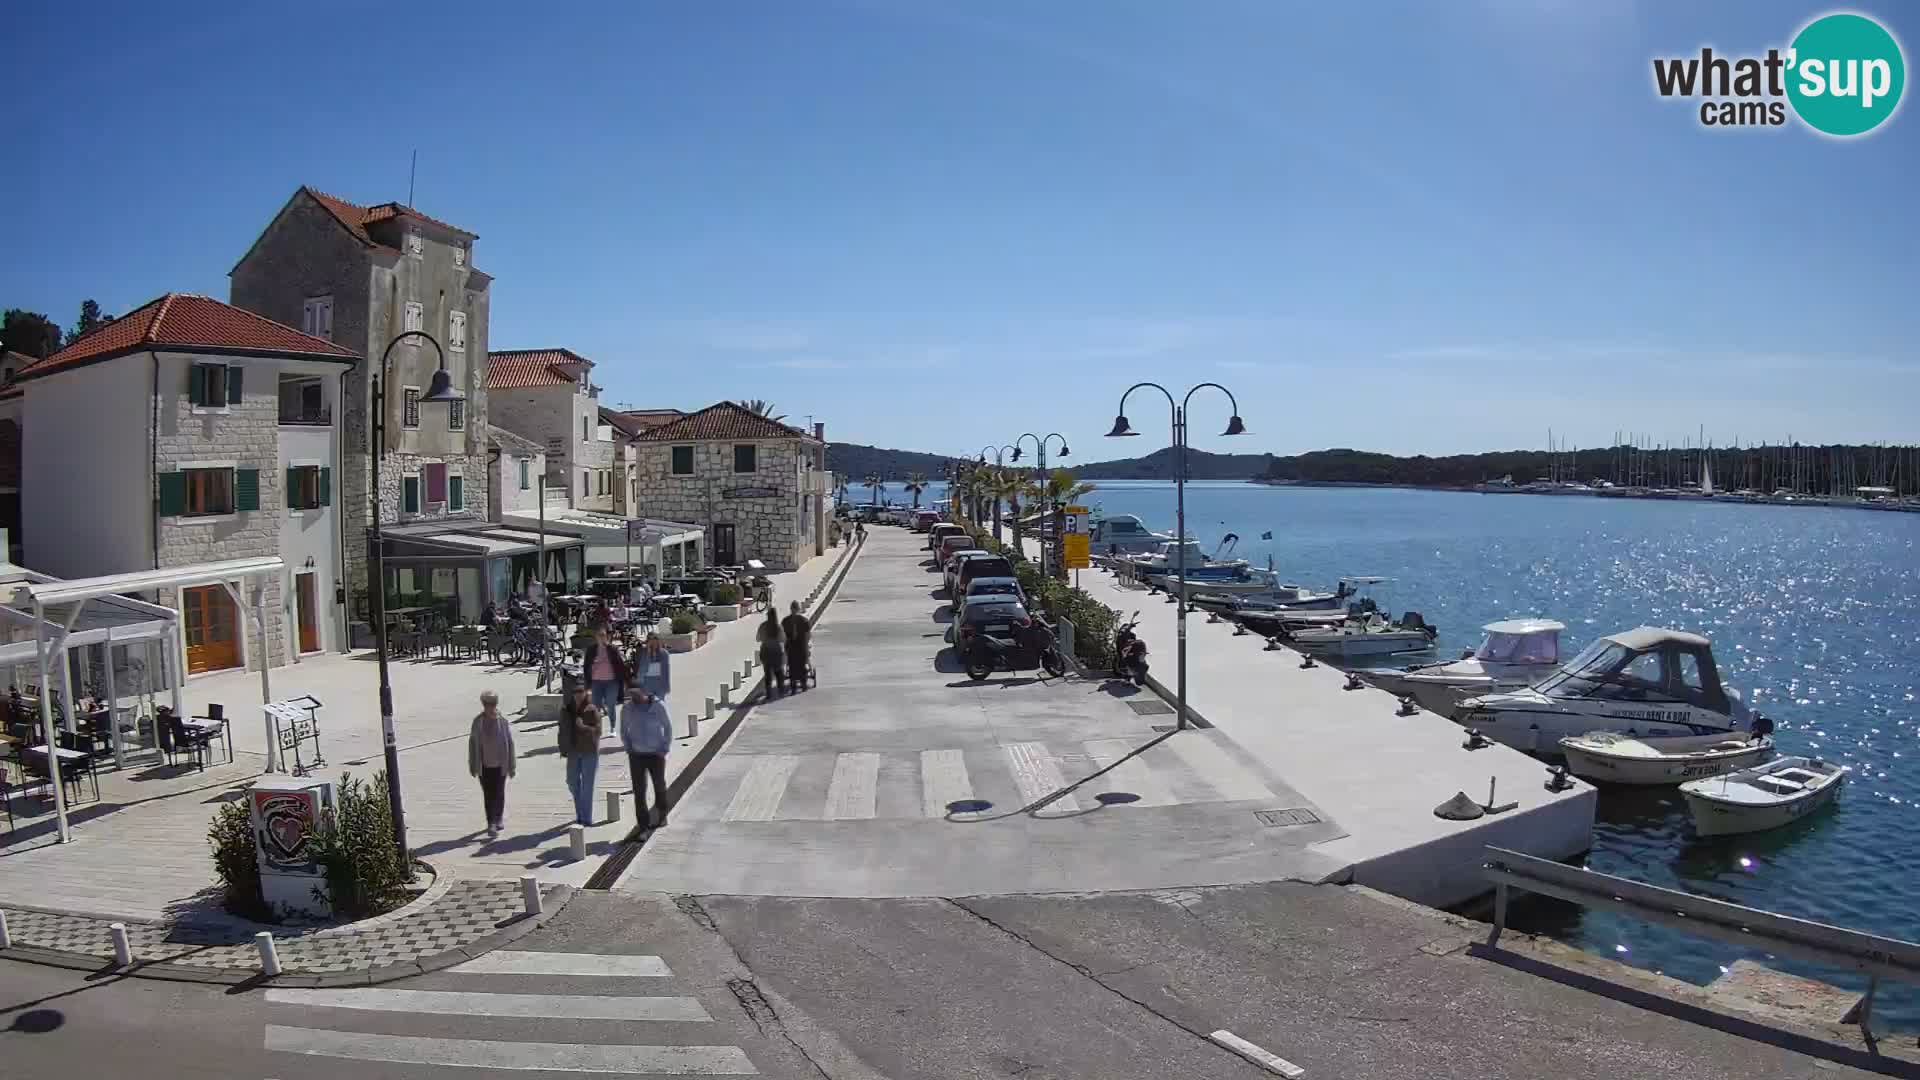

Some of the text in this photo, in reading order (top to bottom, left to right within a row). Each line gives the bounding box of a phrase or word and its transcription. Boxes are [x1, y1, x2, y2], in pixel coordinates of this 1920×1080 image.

[1065, 515, 1076, 531] P
[1646, 710, 1665, 721] RENT
[1673, 711, 1691, 722] BOAT
